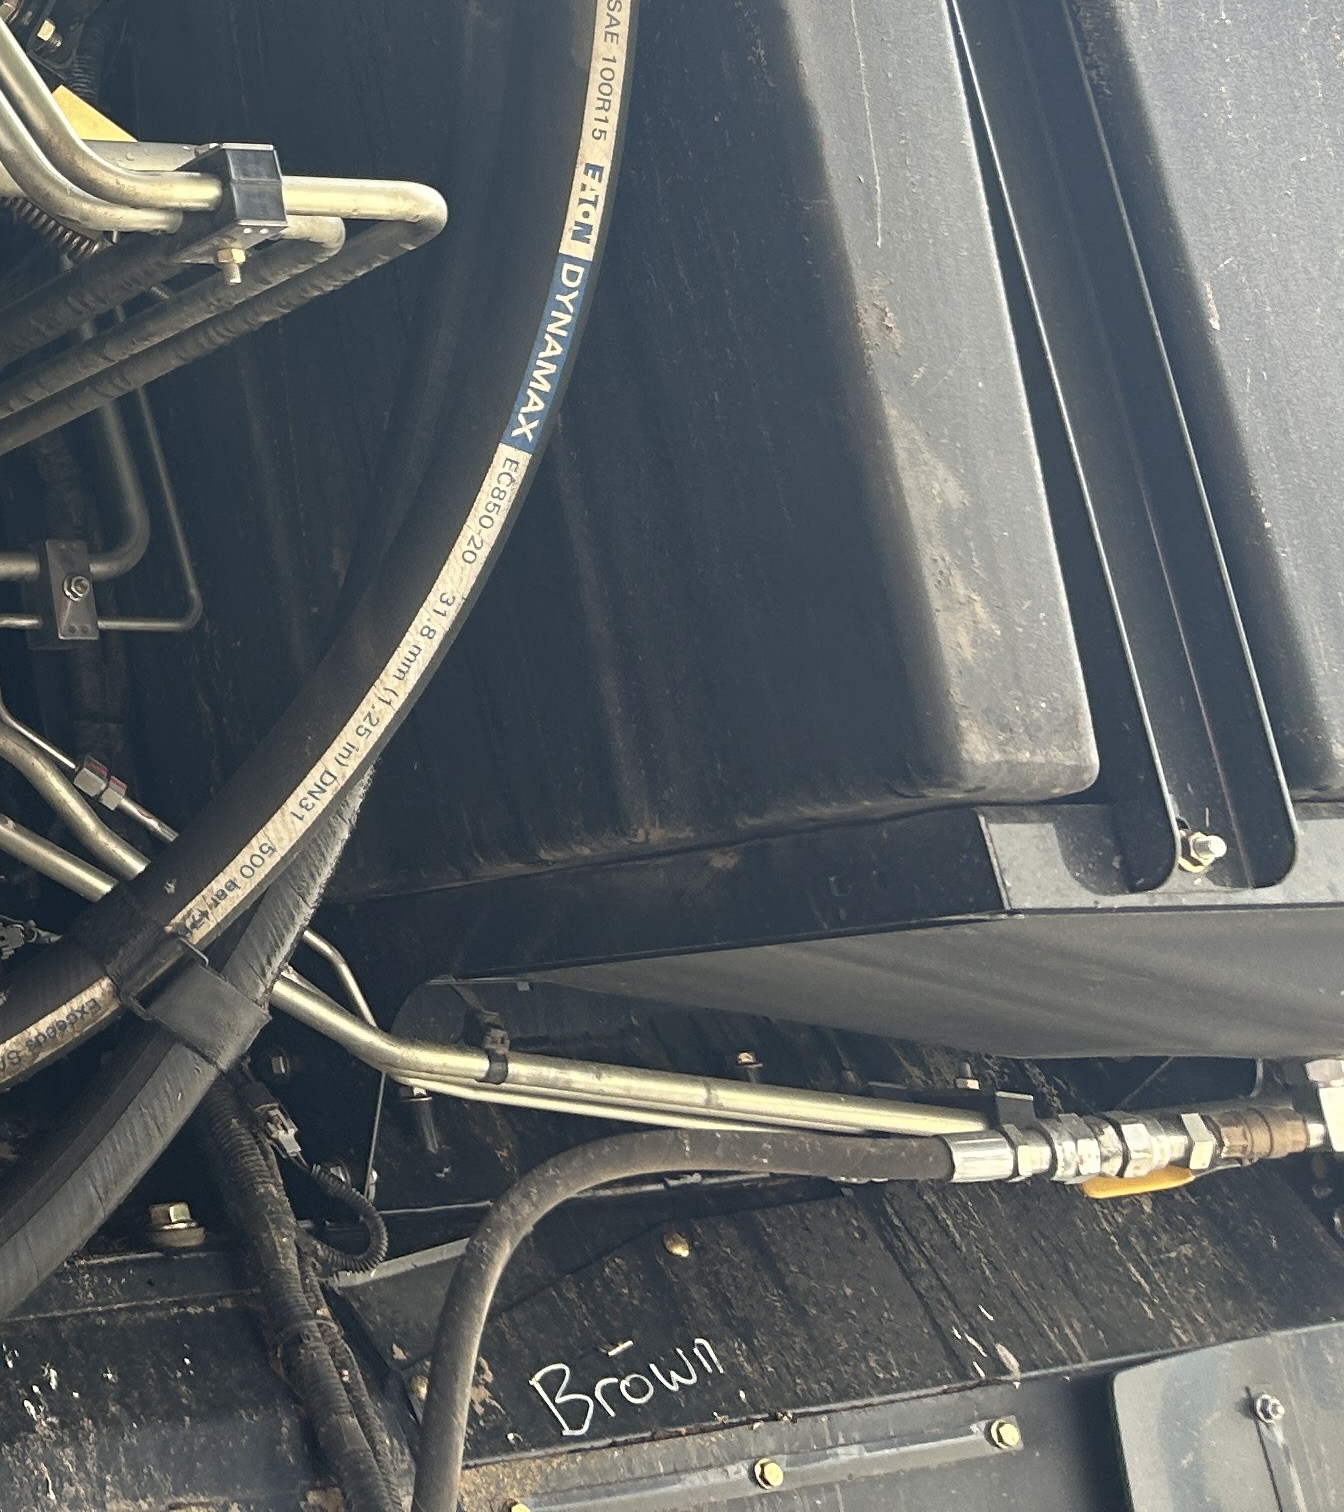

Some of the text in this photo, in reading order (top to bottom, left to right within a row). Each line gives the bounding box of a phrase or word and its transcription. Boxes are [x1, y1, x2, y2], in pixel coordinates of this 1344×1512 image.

[591, 55, 618, 142] 100R15
[511, 262, 585, 443] DYNAMAX
[461, 457, 520, 565] EC850-20
[419, 591, 456, 640] 31.8
[392, 644, 422, 681] mm
[355, 686, 399, 738] (1.25
[333, 741, 360, 768] in)
[290, 769, 337, 822] DN31
[239, 842, 277, 880] 500
[210, 879, 242, 910] bar
[24, 998, 103, 1054] Exceeds
[528, 1337, 725, 1437] Brown
